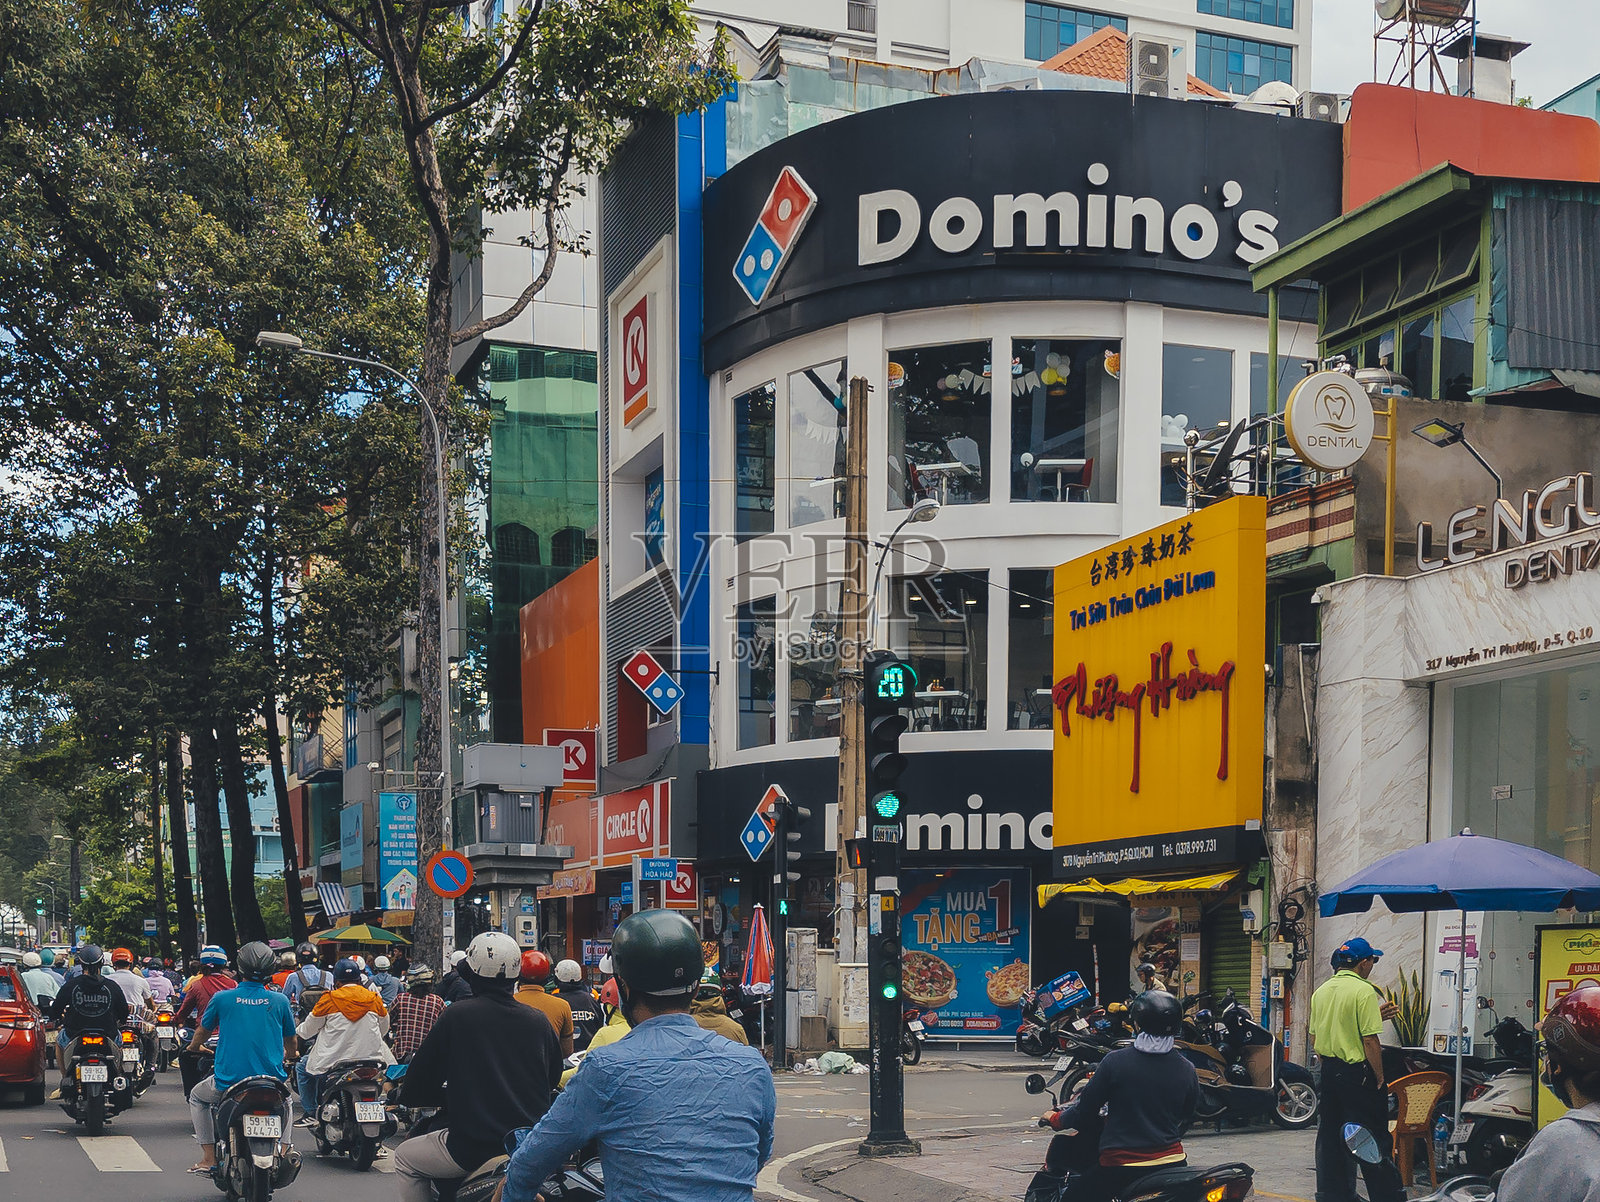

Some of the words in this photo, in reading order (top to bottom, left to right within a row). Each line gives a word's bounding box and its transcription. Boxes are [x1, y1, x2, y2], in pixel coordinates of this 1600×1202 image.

[858, 163, 1279, 265] Domino's
[629, 322, 644, 376] K
[1307, 436, 1363, 448] DENTAL
[1089, 521, 1195, 587] 台湾珍珠奶茶
[1186, 570, 1216, 595] Loan
[1426, 657, 1442, 671] 317
[1566, 626, 1593, 642] Q.10
[562, 743, 585, 769] K
[606, 810, 636, 840] CIRCLE
[638, 803, 650, 838] K
[825, 793, 1053, 851] mino
[1176, 839, 1217, 855] 0378.999.731
[674, 874, 691, 893] K
[946, 892, 987, 911] MUA
[987, 879, 1011, 945] 1
[913, 908, 980, 951] TẶNG
[236, 997, 269, 1006] PHILIPS
[247, 1125, 279, 1136] 344.76
[249, 1116, 275, 1127] 59-N3
